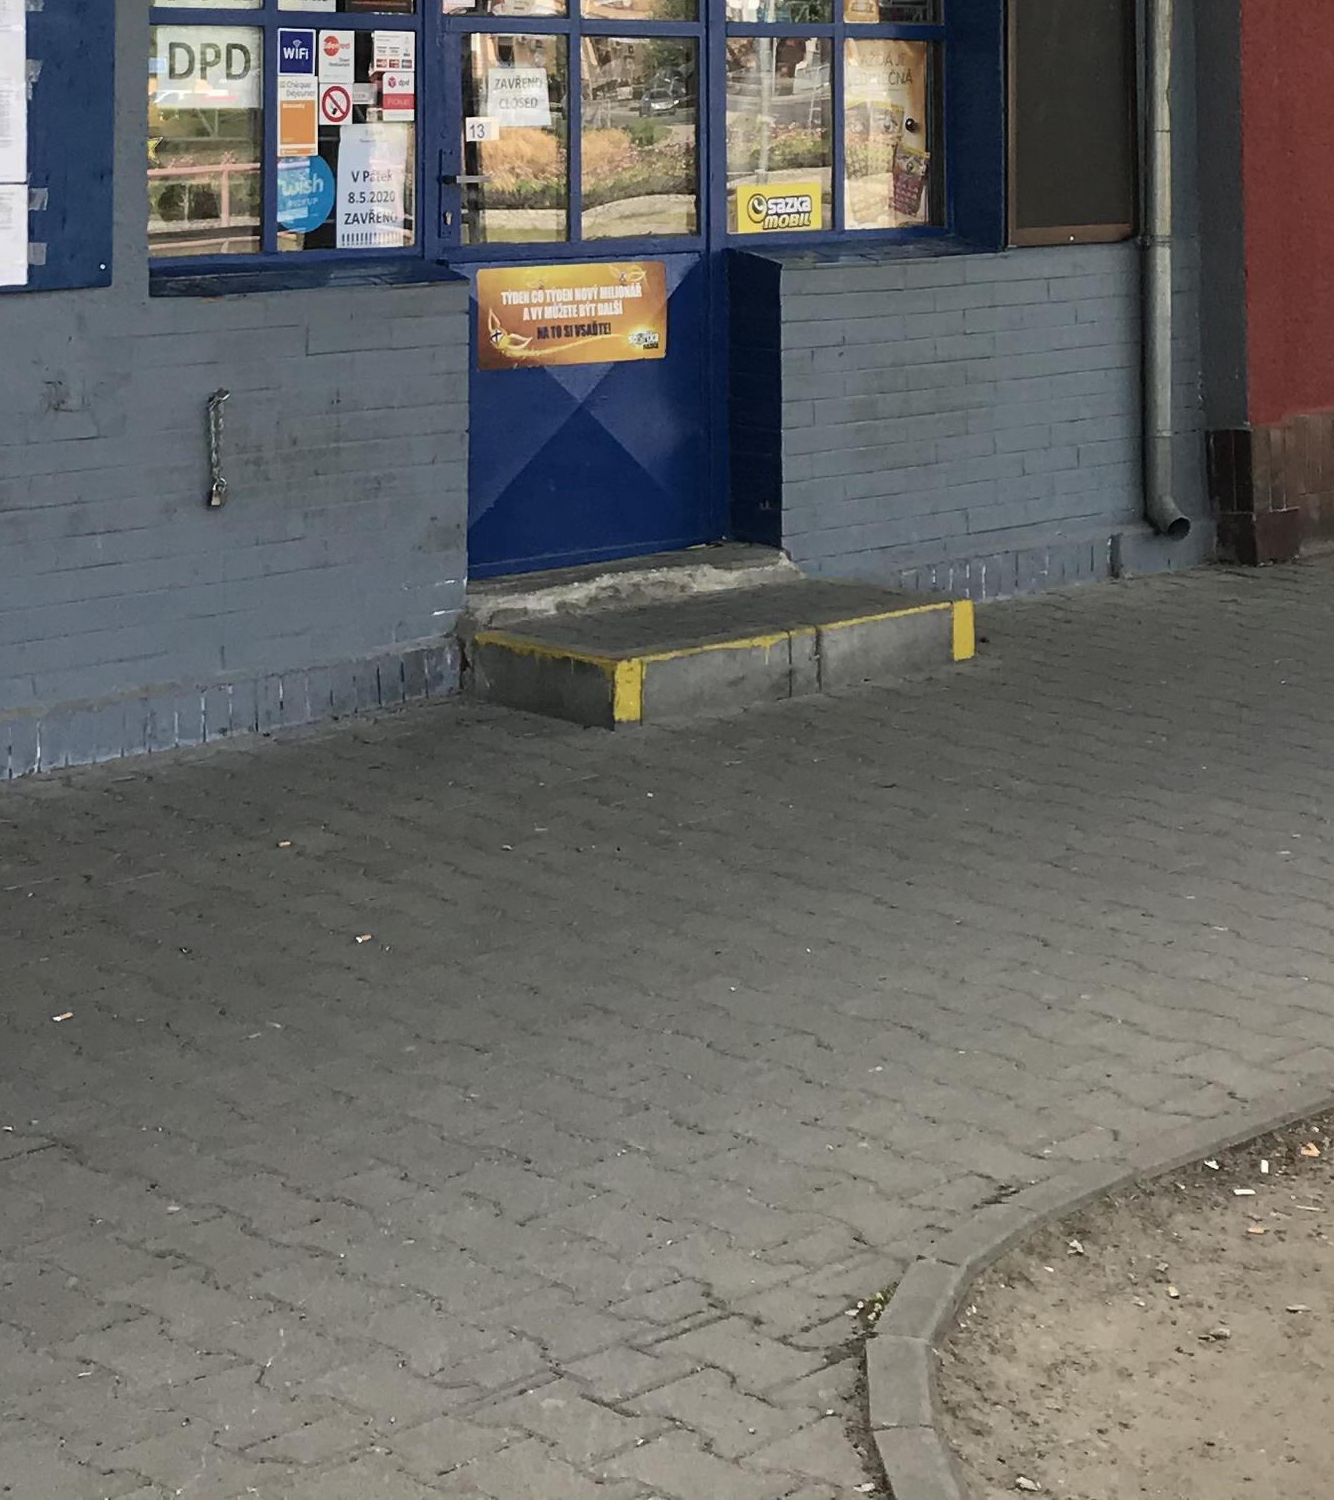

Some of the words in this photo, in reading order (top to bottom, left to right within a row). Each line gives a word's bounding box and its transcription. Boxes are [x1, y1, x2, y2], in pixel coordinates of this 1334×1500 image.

[167, 41, 252, 81] DPD
[493, 74, 543, 91] ZAVŘENO
[498, 95, 539, 109] CLOSED
[468, 124, 485, 139] 13
[351, 171, 360, 182] V
[363, 170, 393, 182] Pátek
[347, 191, 395, 204] 8.5.2020
[766, 194, 811, 215] sazka
[344, 209, 398, 225] ZAVŘENO
[762, 211, 811, 230] MOBIL
[501, 288, 529, 305] TÝDEN
[545, 287, 573, 303] TÝDEN
[522, 310, 530, 321] A
[532, 308, 543, 320] VY
[598, 300, 623, 315] DALŠÍ
[537, 327, 549, 339] NA
[551, 326, 562, 339] TO
[564, 325, 573, 338] SI
